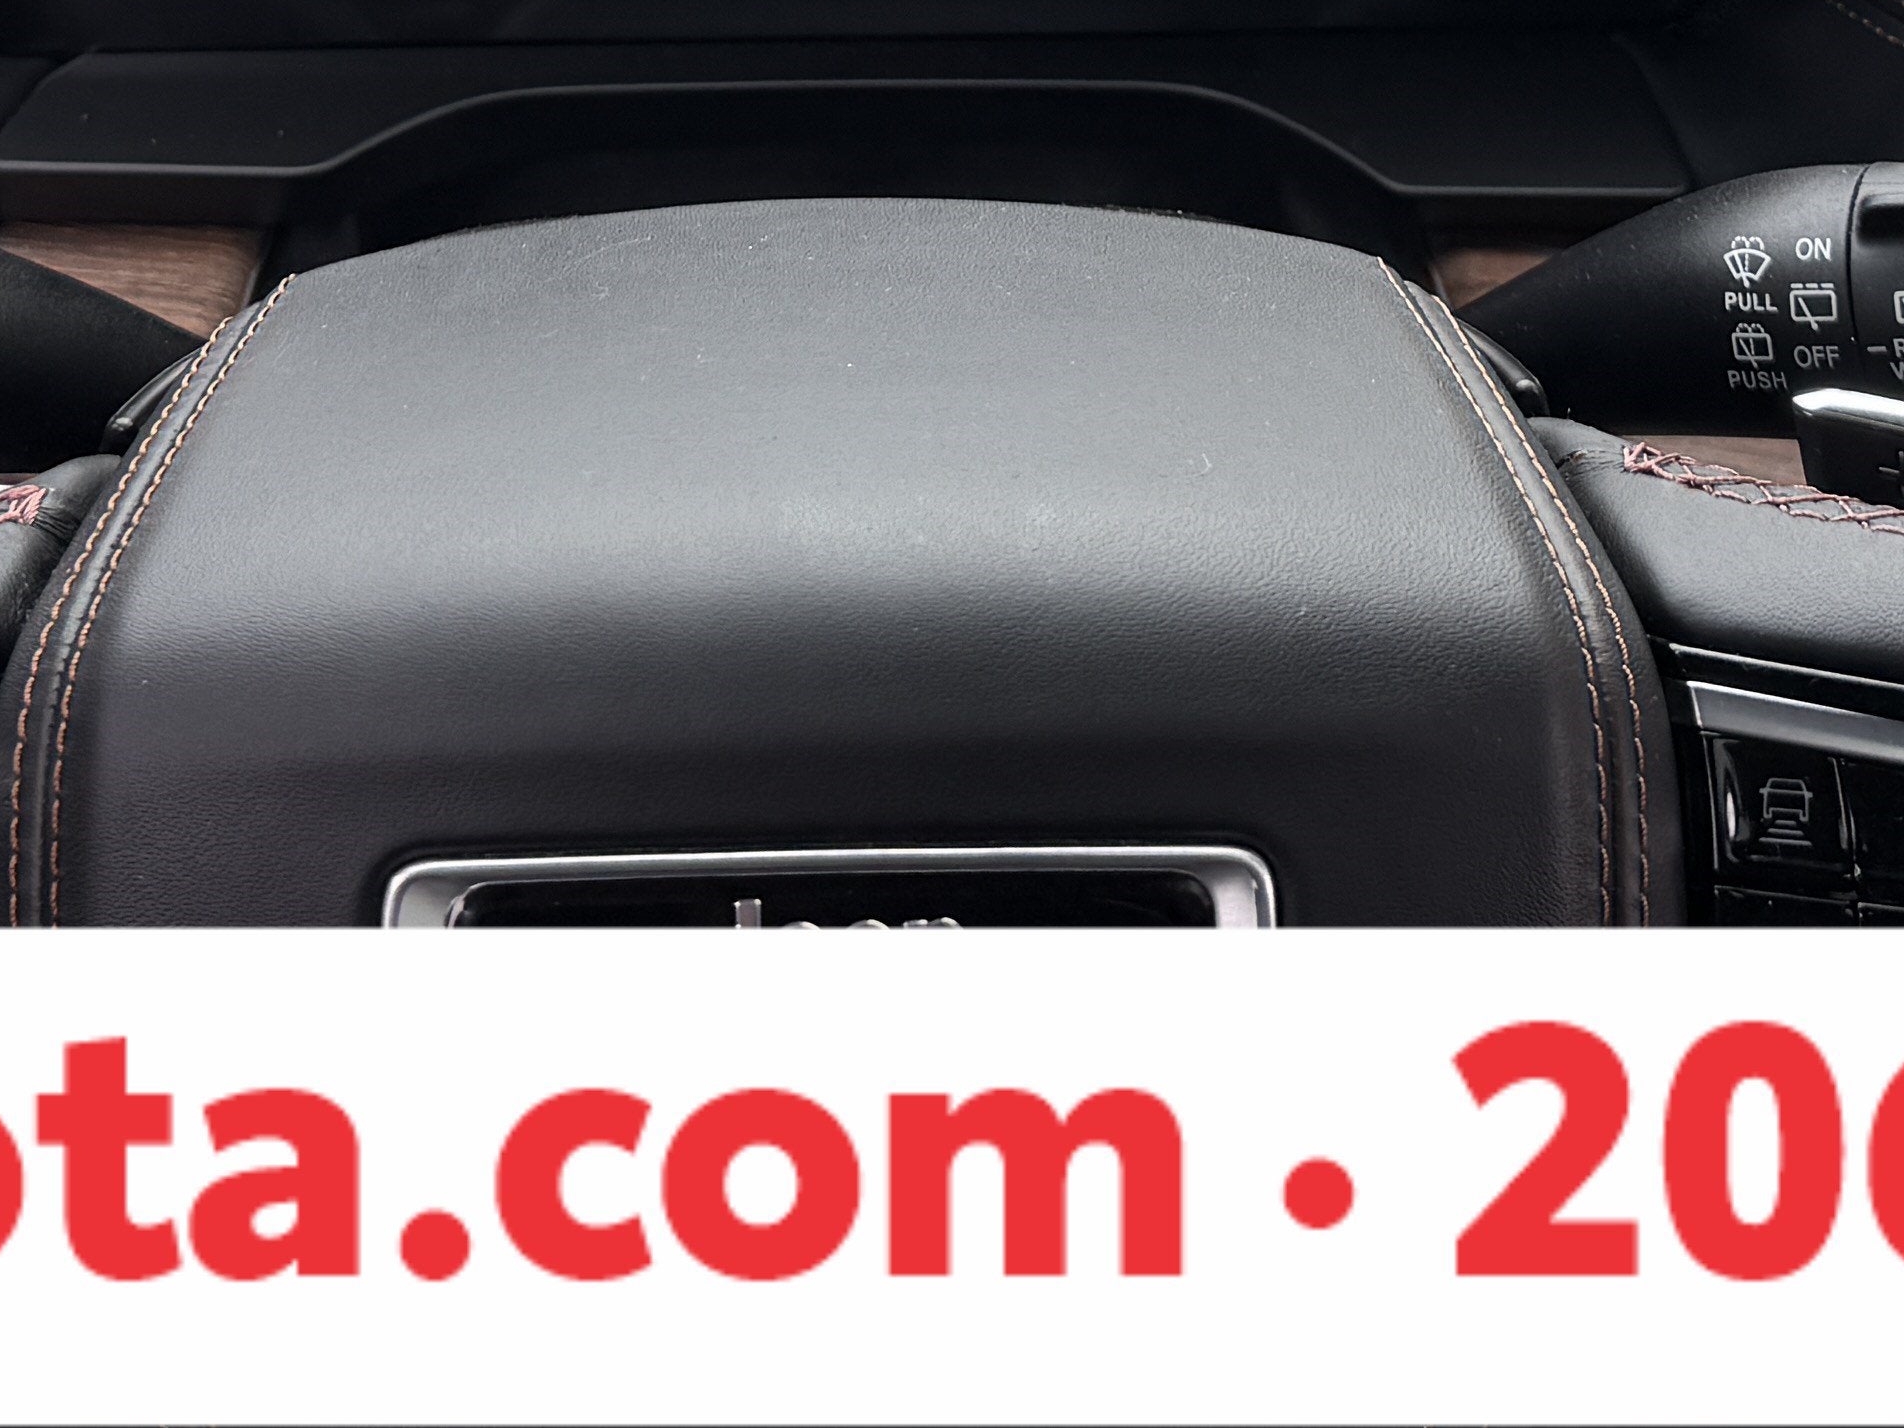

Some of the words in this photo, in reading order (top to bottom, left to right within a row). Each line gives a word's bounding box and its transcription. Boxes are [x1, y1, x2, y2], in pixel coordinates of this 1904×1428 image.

[1795, 237, 1832, 261] ON
[1724, 291, 1779, 313] PULL
[1793, 344, 1841, 369] OFF
[1726, 369, 1788, 390] PUSH
